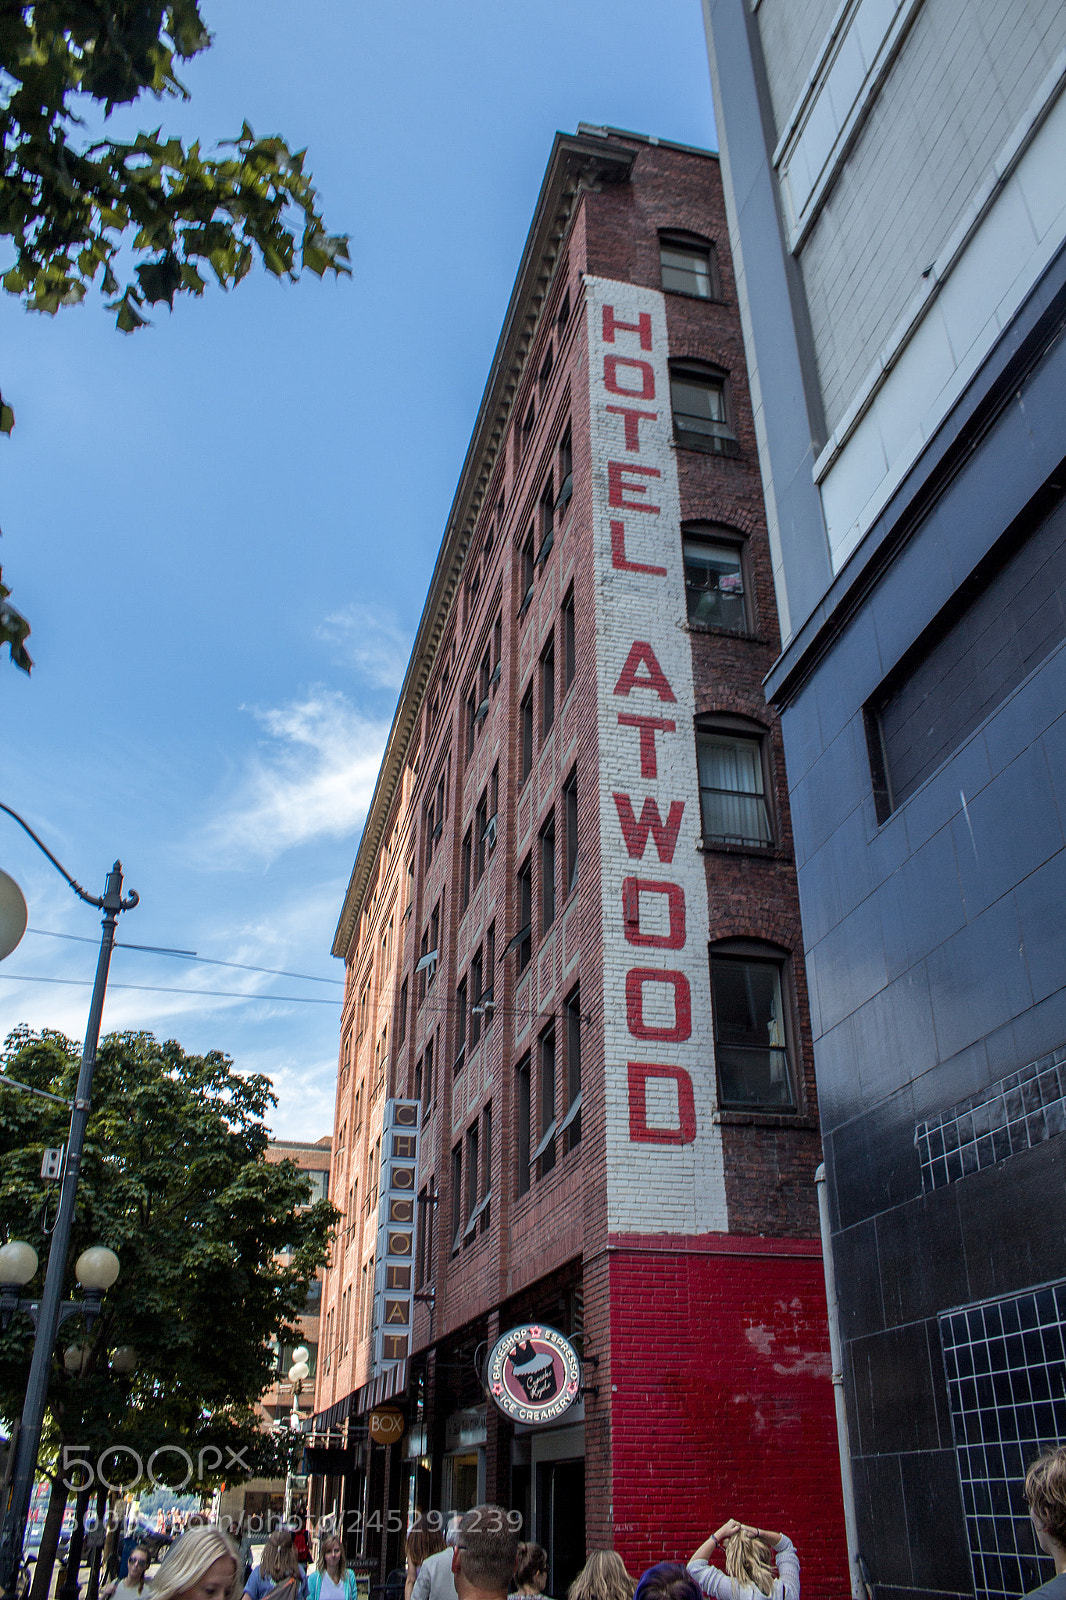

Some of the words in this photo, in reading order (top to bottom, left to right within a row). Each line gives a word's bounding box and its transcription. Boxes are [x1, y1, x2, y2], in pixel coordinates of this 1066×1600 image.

[601, 304, 668, 577] HOTEL
[613, 641, 697, 1146] ATWOOD
[387, 1105, 415, 1358] CHOCOLAT
[492, 1329, 527, 1380] BAKESHOP
[544, 1330, 578, 1380] ESPRESSO
[371, 1415, 402, 1433] BOX
[499, 1396, 517, 1414] ICE
[518, 1393, 571, 1421] CREAMERY
